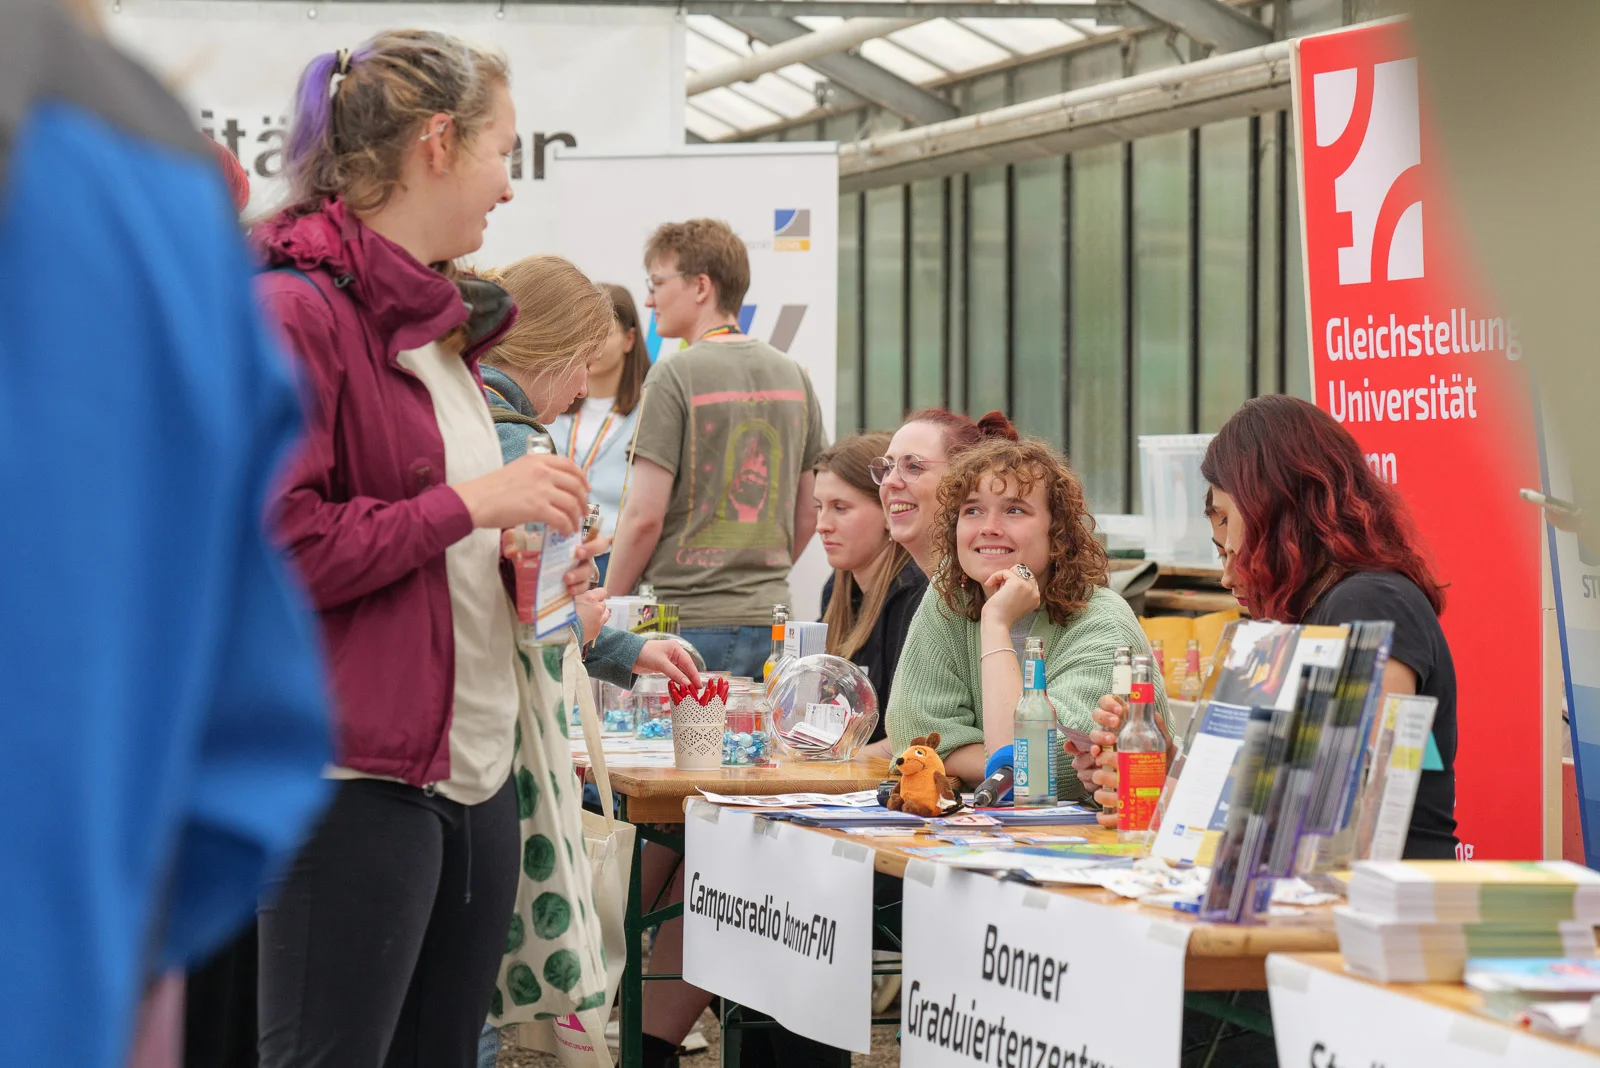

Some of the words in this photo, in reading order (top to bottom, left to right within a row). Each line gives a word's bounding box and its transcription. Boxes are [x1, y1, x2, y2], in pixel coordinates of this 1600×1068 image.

[1326, 308, 1523, 361] Gleichstellung
[1329, 373, 1478, 423] Universität
[1364, 452, 1398, 484] nn
[1582, 574, 1600, 600] ST
[689, 871, 781, 941] Campusradio
[782, 901, 836, 965] bonnFM
[982, 923, 1068, 1003] Bonner
